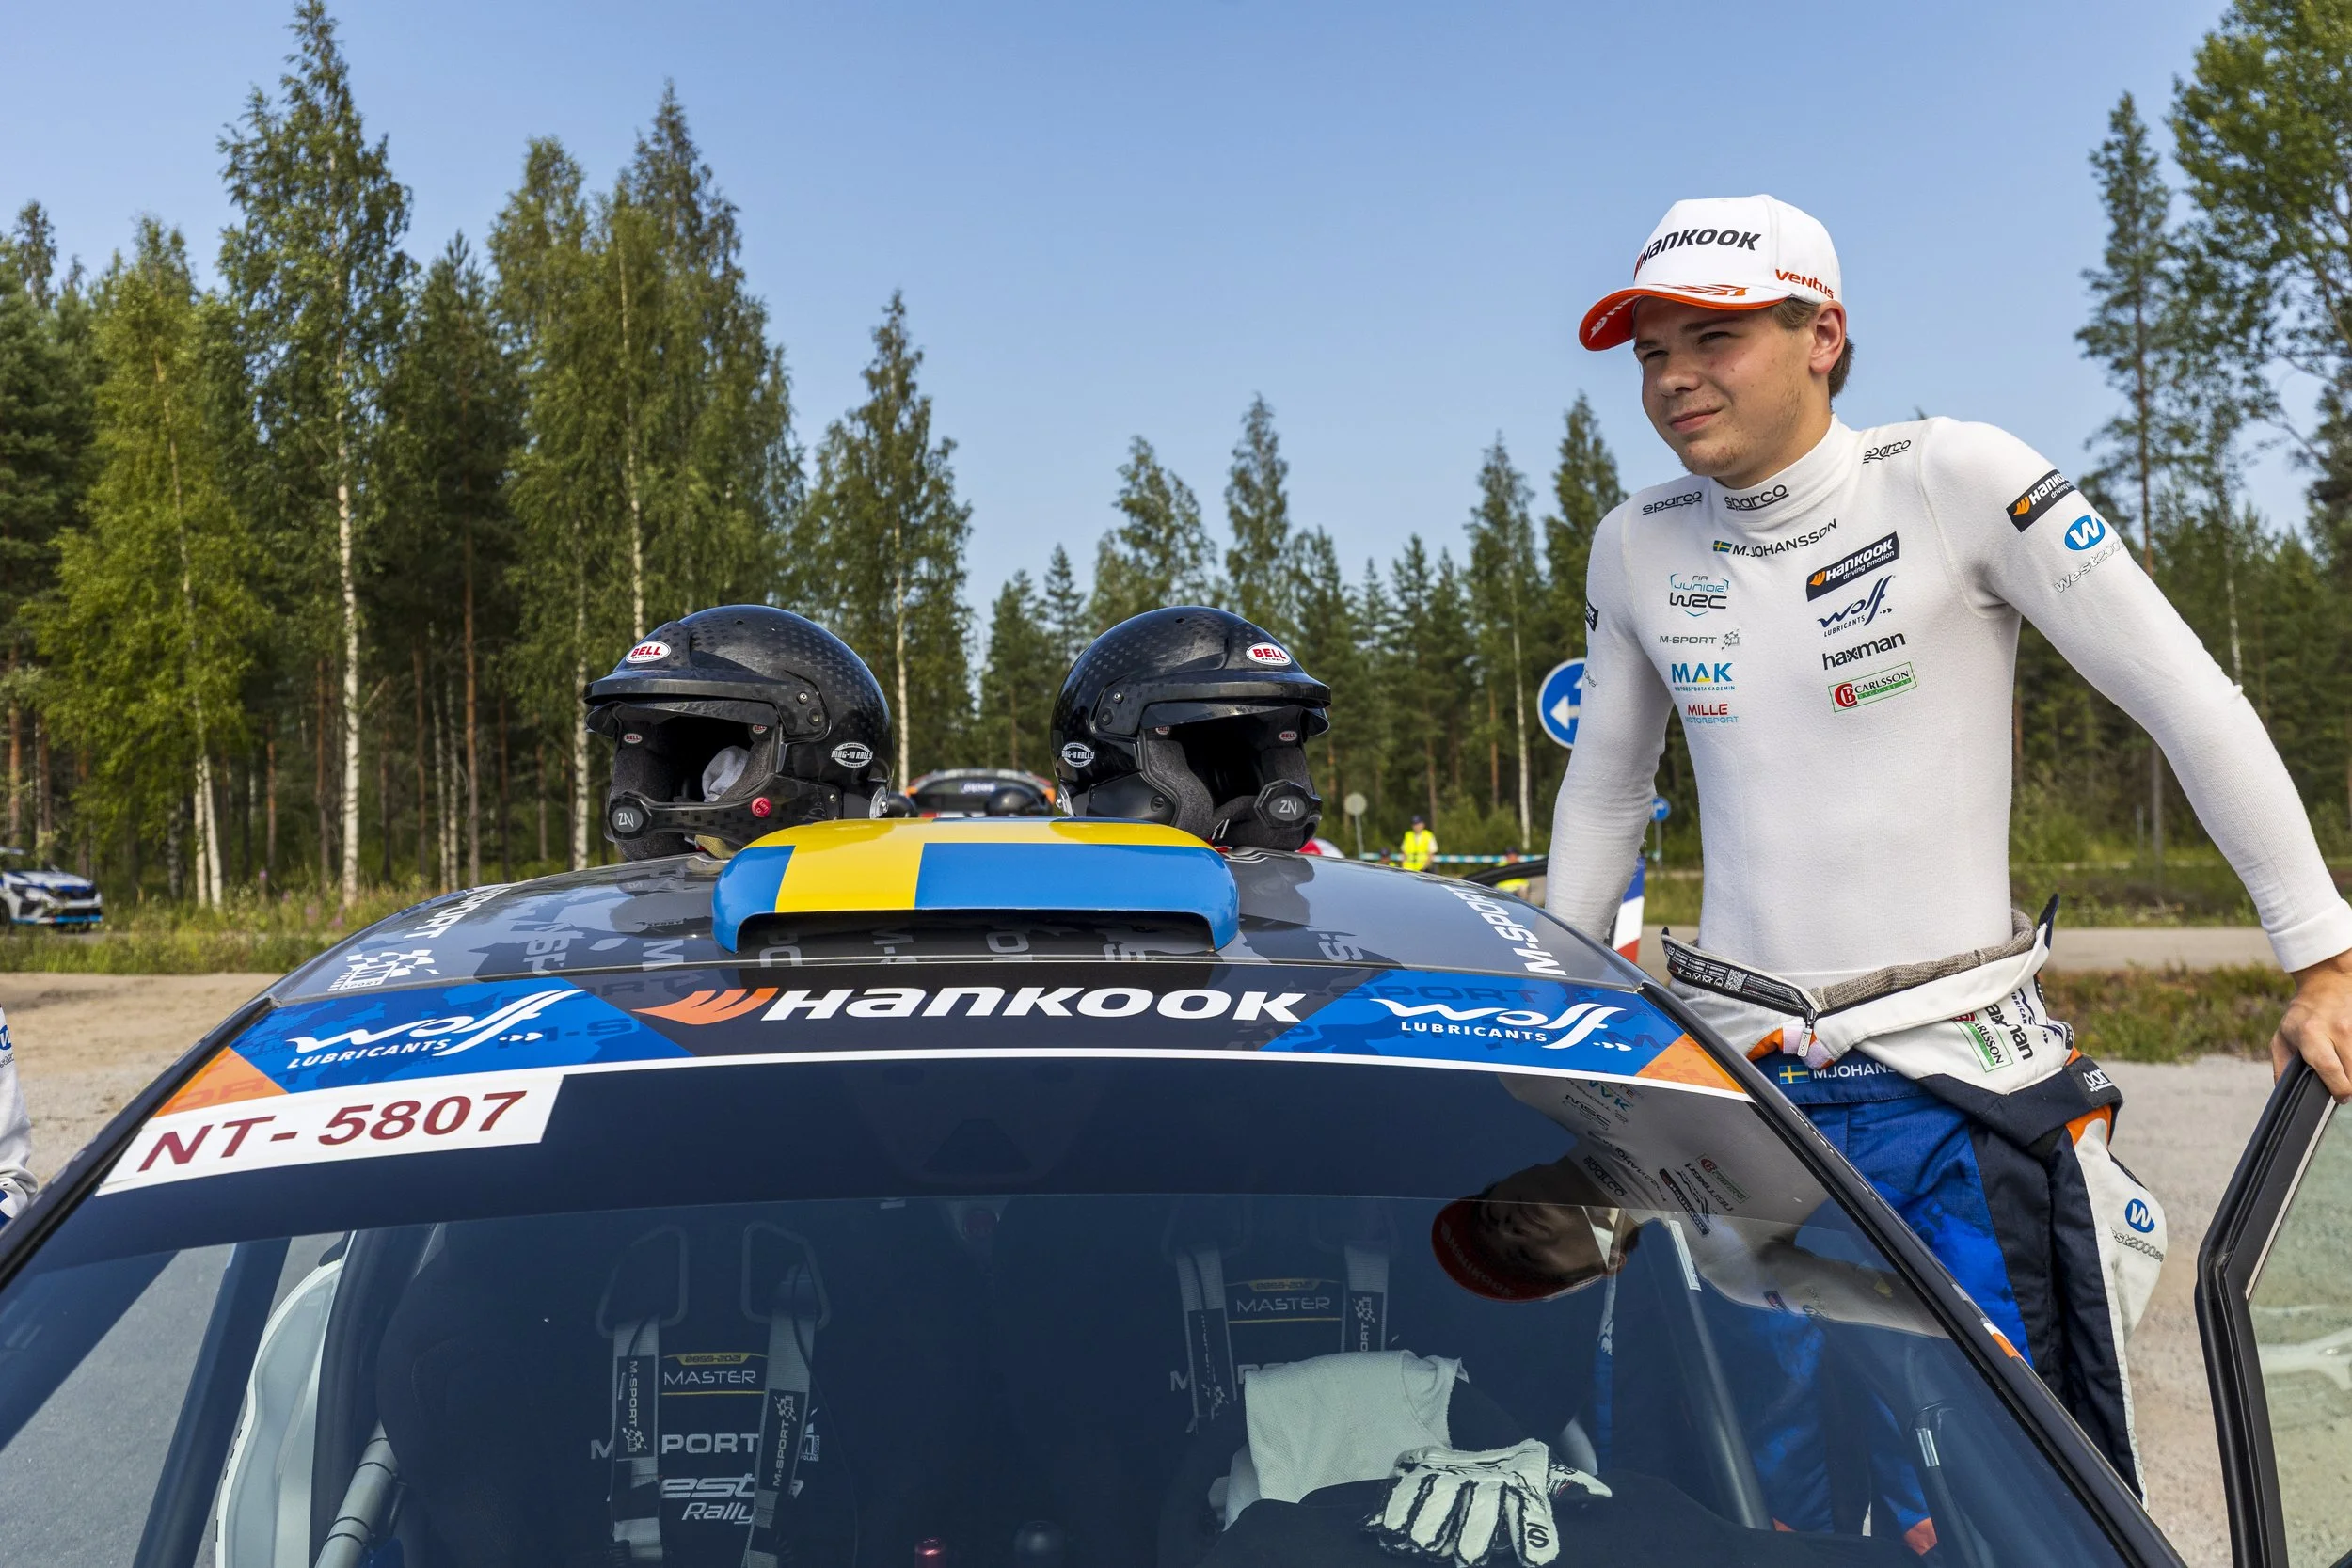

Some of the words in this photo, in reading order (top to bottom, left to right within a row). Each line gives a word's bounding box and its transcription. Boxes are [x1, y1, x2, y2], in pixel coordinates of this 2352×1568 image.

[1642, 491, 1702, 515] sparco
[1724, 484, 1789, 511] sparco
[1843, 565, 1867, 581] driving
[1867, 549, 1895, 572] emotion
[1824, 616, 1867, 638] LUBRICANTS
[631, 646, 660, 657] BELL
[1660, 636, 1717, 644] M-SPORT
[1822, 632, 1906, 670] haxman
[1252, 648, 1287, 660] BELL
[1854, 670, 1910, 694] CARLSSON
[1688, 704, 1728, 716] MILLE
[1401, 1022, 1548, 1042] LUBRICANTS
[286, 1038, 451, 1069] LUBRICANTS
[1236, 1296, 1330, 1313] MASTER
[664, 1370, 756, 1386] MASTER
[628, 1361, 638, 1428] M-SPORT
[773, 1419, 790, 1487] M-SPORT
[681, 1502, 755, 1525] Rally
